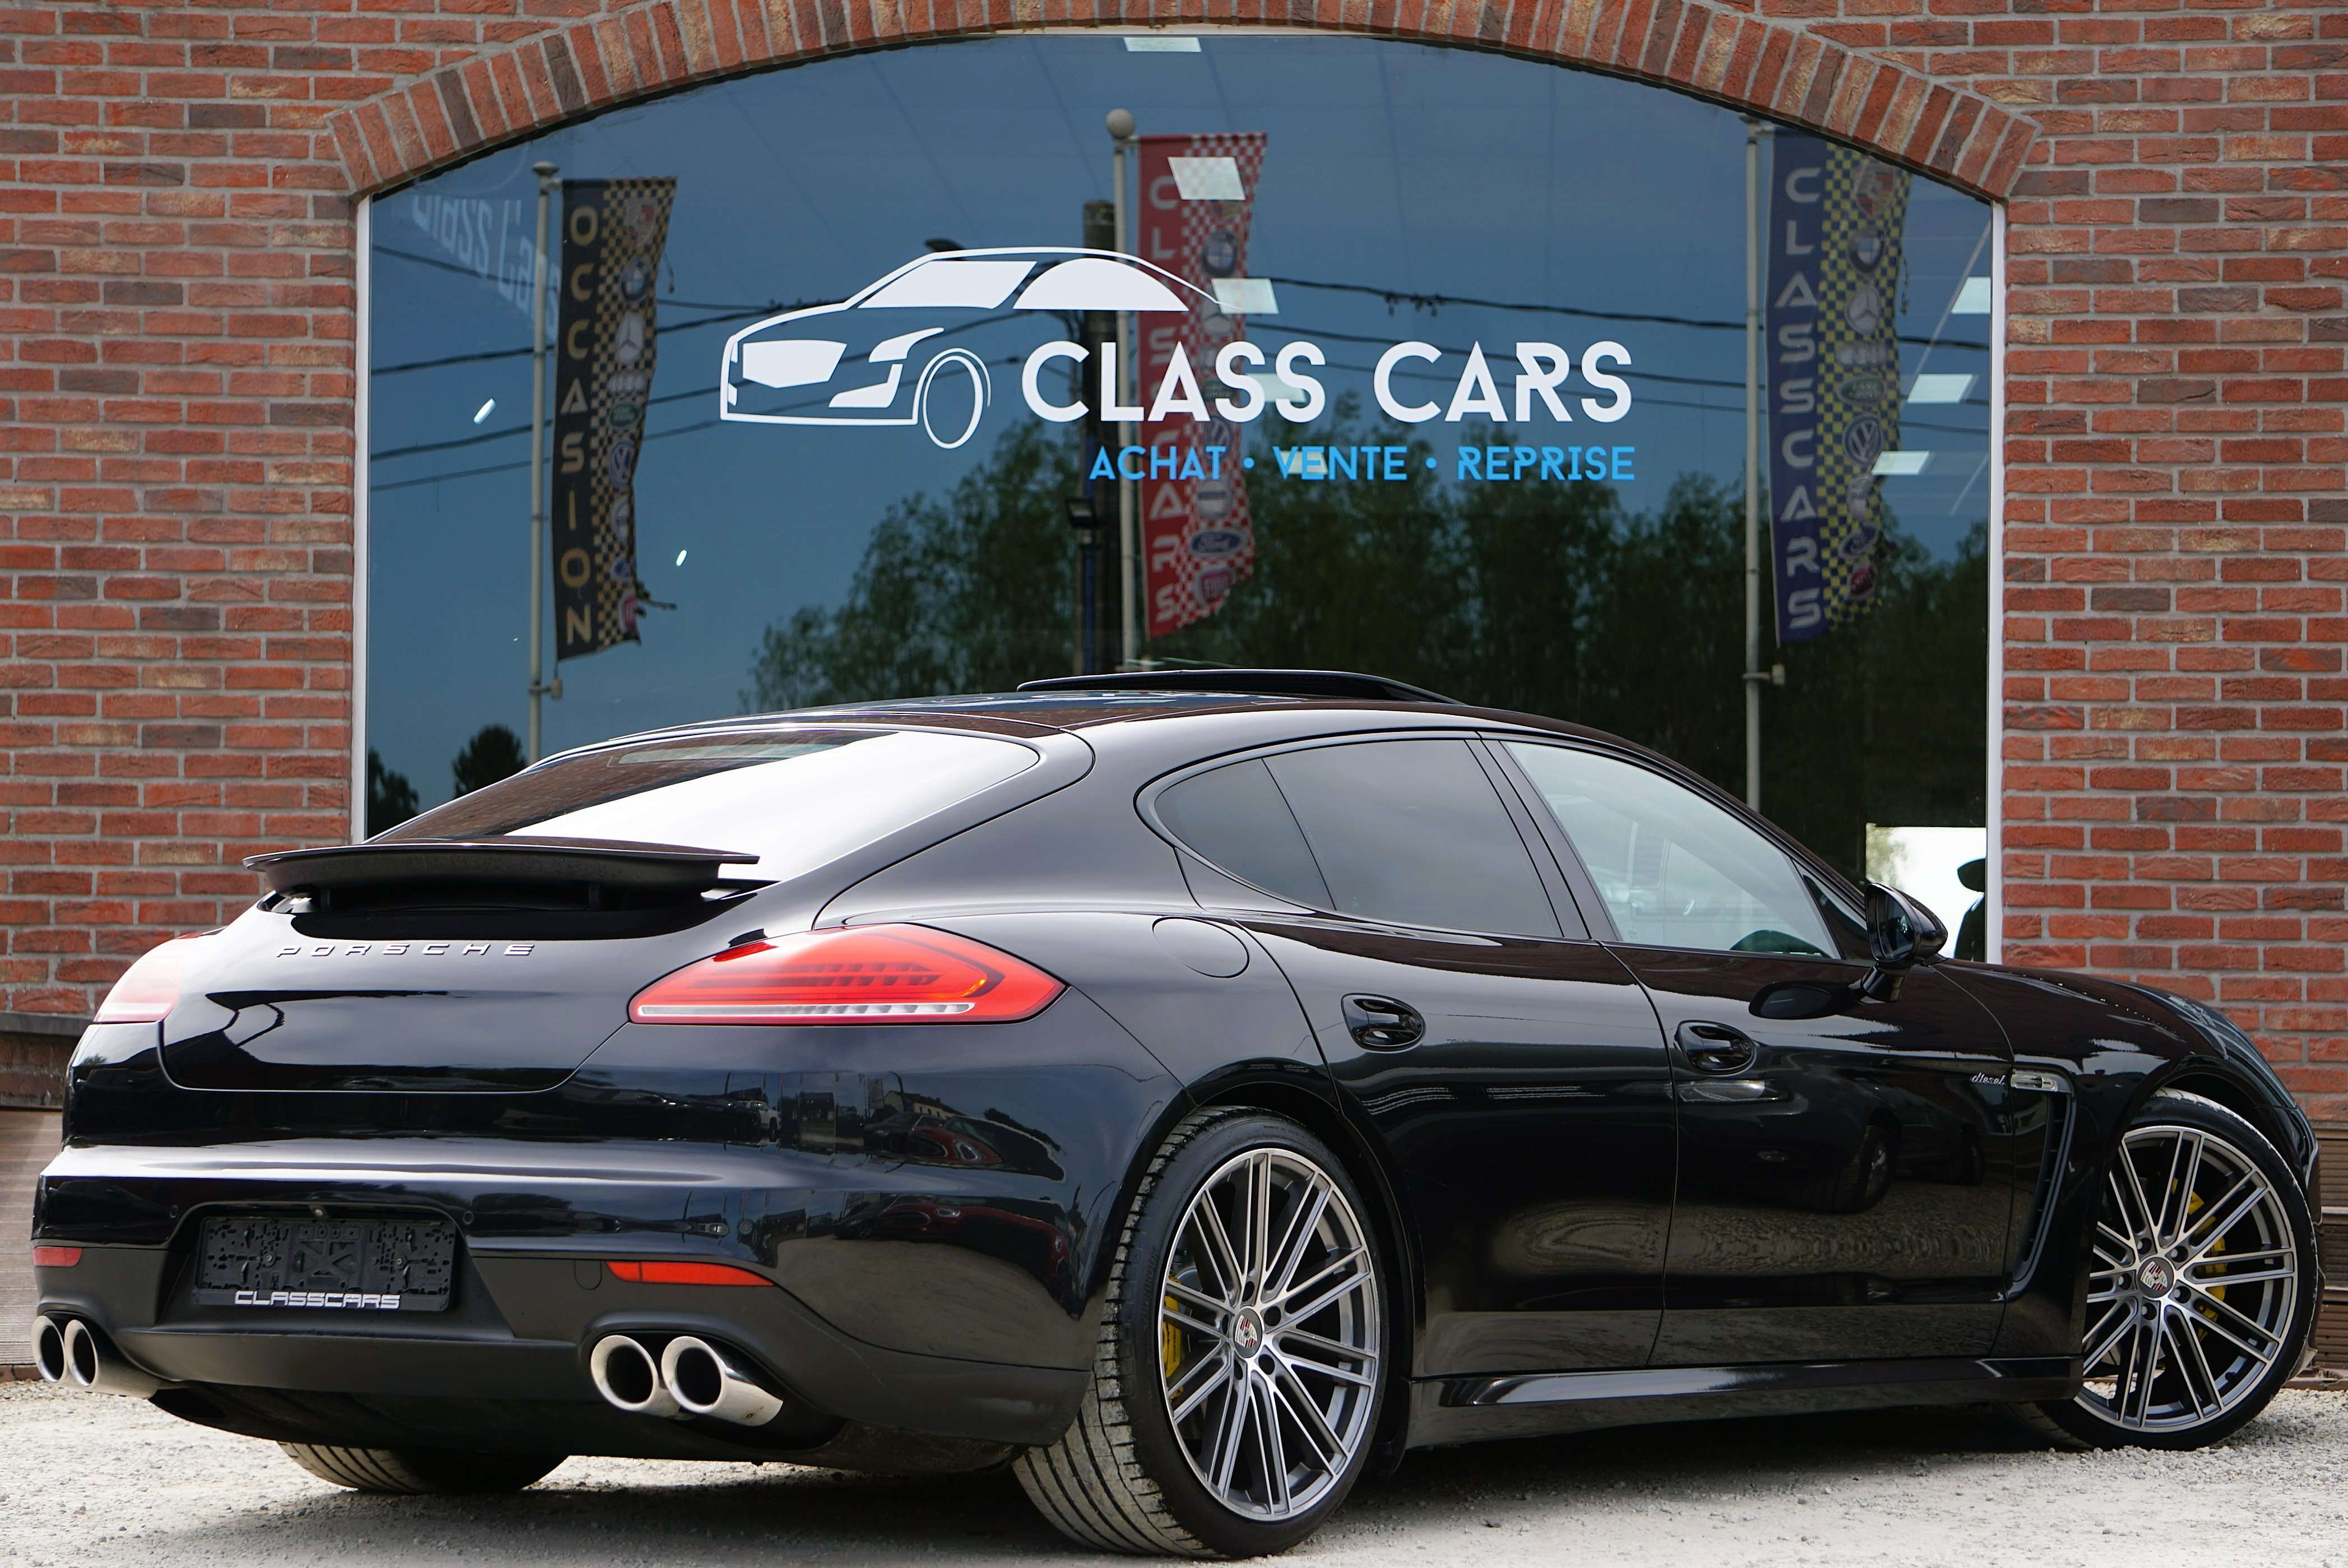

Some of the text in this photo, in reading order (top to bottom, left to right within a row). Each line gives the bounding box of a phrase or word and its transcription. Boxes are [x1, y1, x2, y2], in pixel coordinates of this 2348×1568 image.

[1022, 341, 1632, 423] CLASS CARS
[559, 205, 599, 644] OCCASION
[1089, 446, 1636, 481] ACHAT VENTE REPRISE
[276, 943, 534, 957] PORSCHE
[234, 1291, 401, 1309] CLASSCARS
